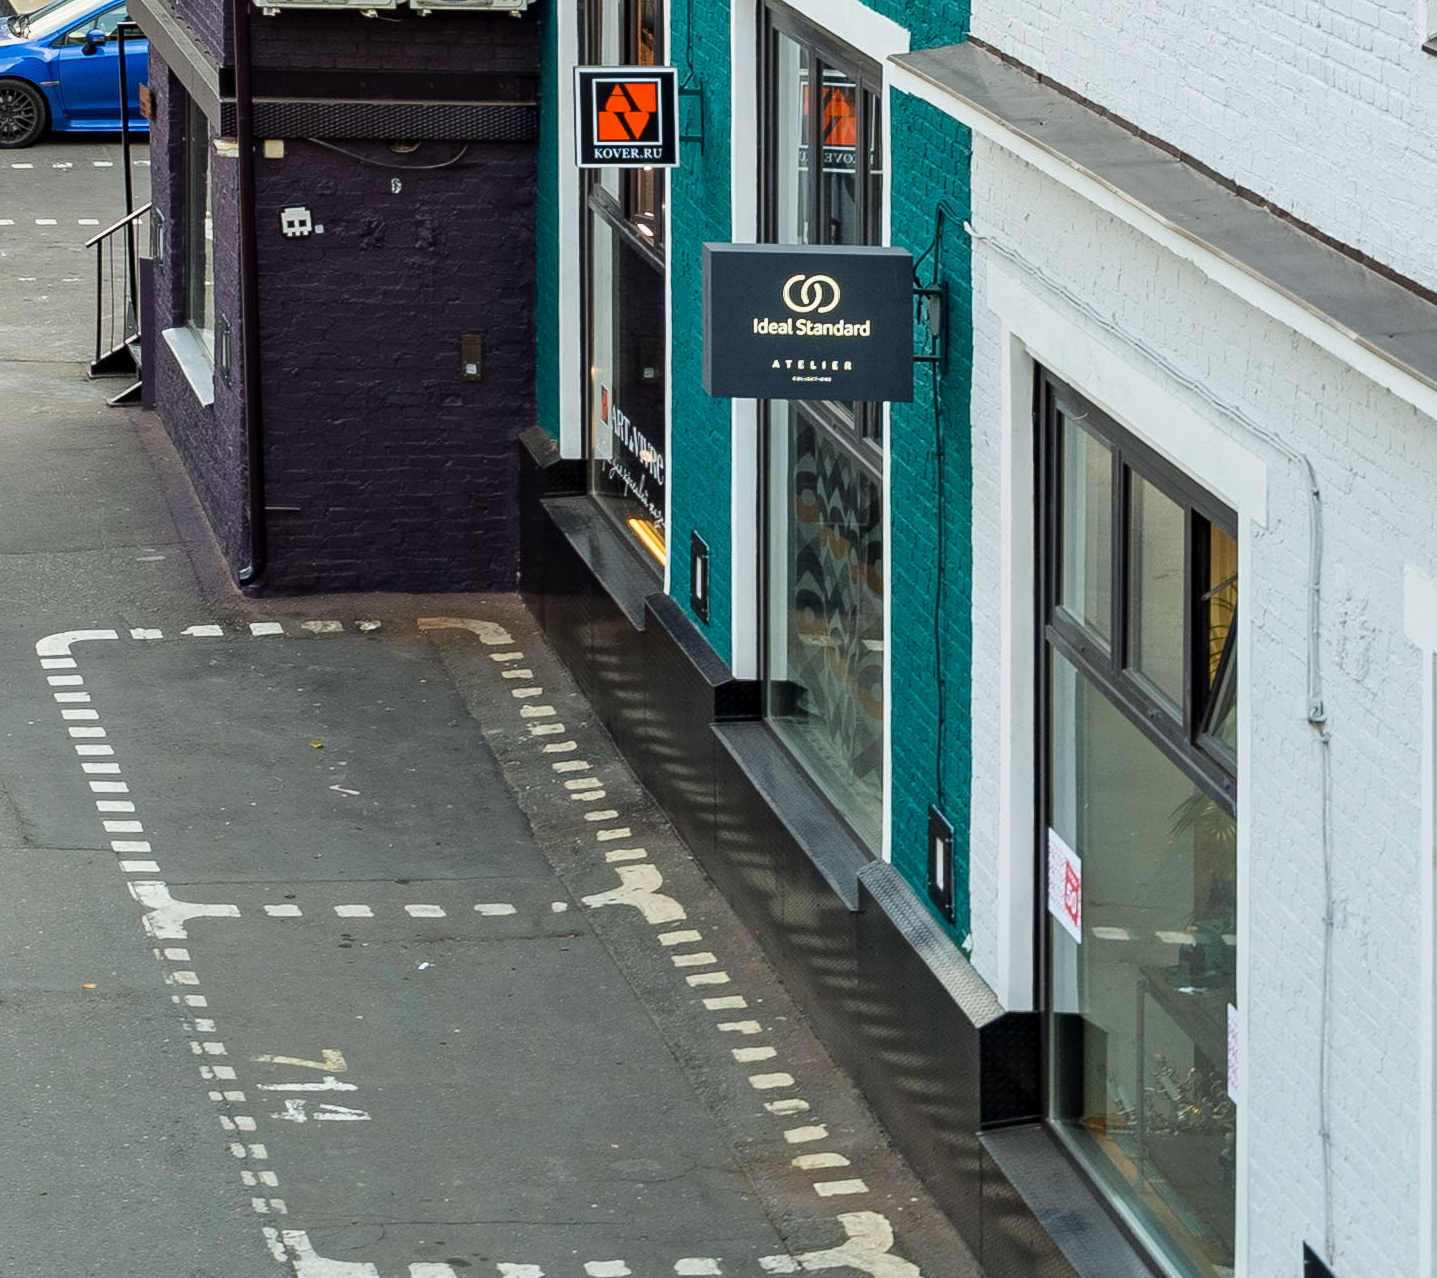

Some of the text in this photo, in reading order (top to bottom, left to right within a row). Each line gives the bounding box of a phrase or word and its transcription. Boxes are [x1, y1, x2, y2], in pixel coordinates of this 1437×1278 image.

[594, 148, 662, 159] KOVER.RU
[753, 317, 871, 337] Ideal Standard
[772, 359, 852, 371] ATELIER
